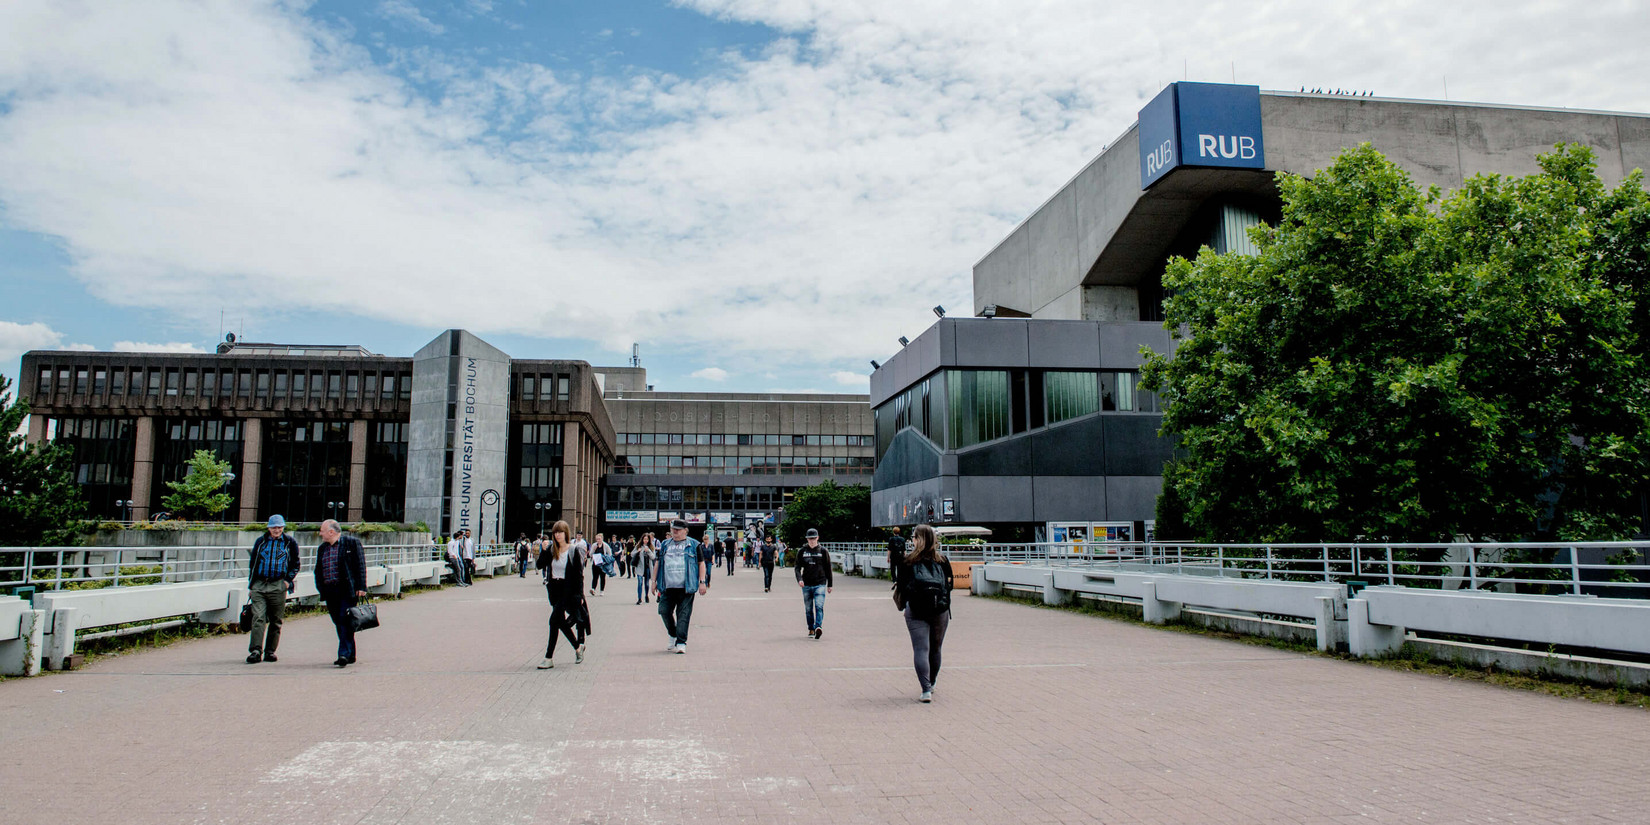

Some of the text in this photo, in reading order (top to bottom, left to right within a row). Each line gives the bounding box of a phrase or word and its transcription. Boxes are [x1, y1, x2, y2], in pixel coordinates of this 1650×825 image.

[1146, 139, 1172, 178] RUB
[1199, 134, 1256, 159] RUB
[460, 358, 477, 537] HR-UNIVERSITÄT BOCHUM
